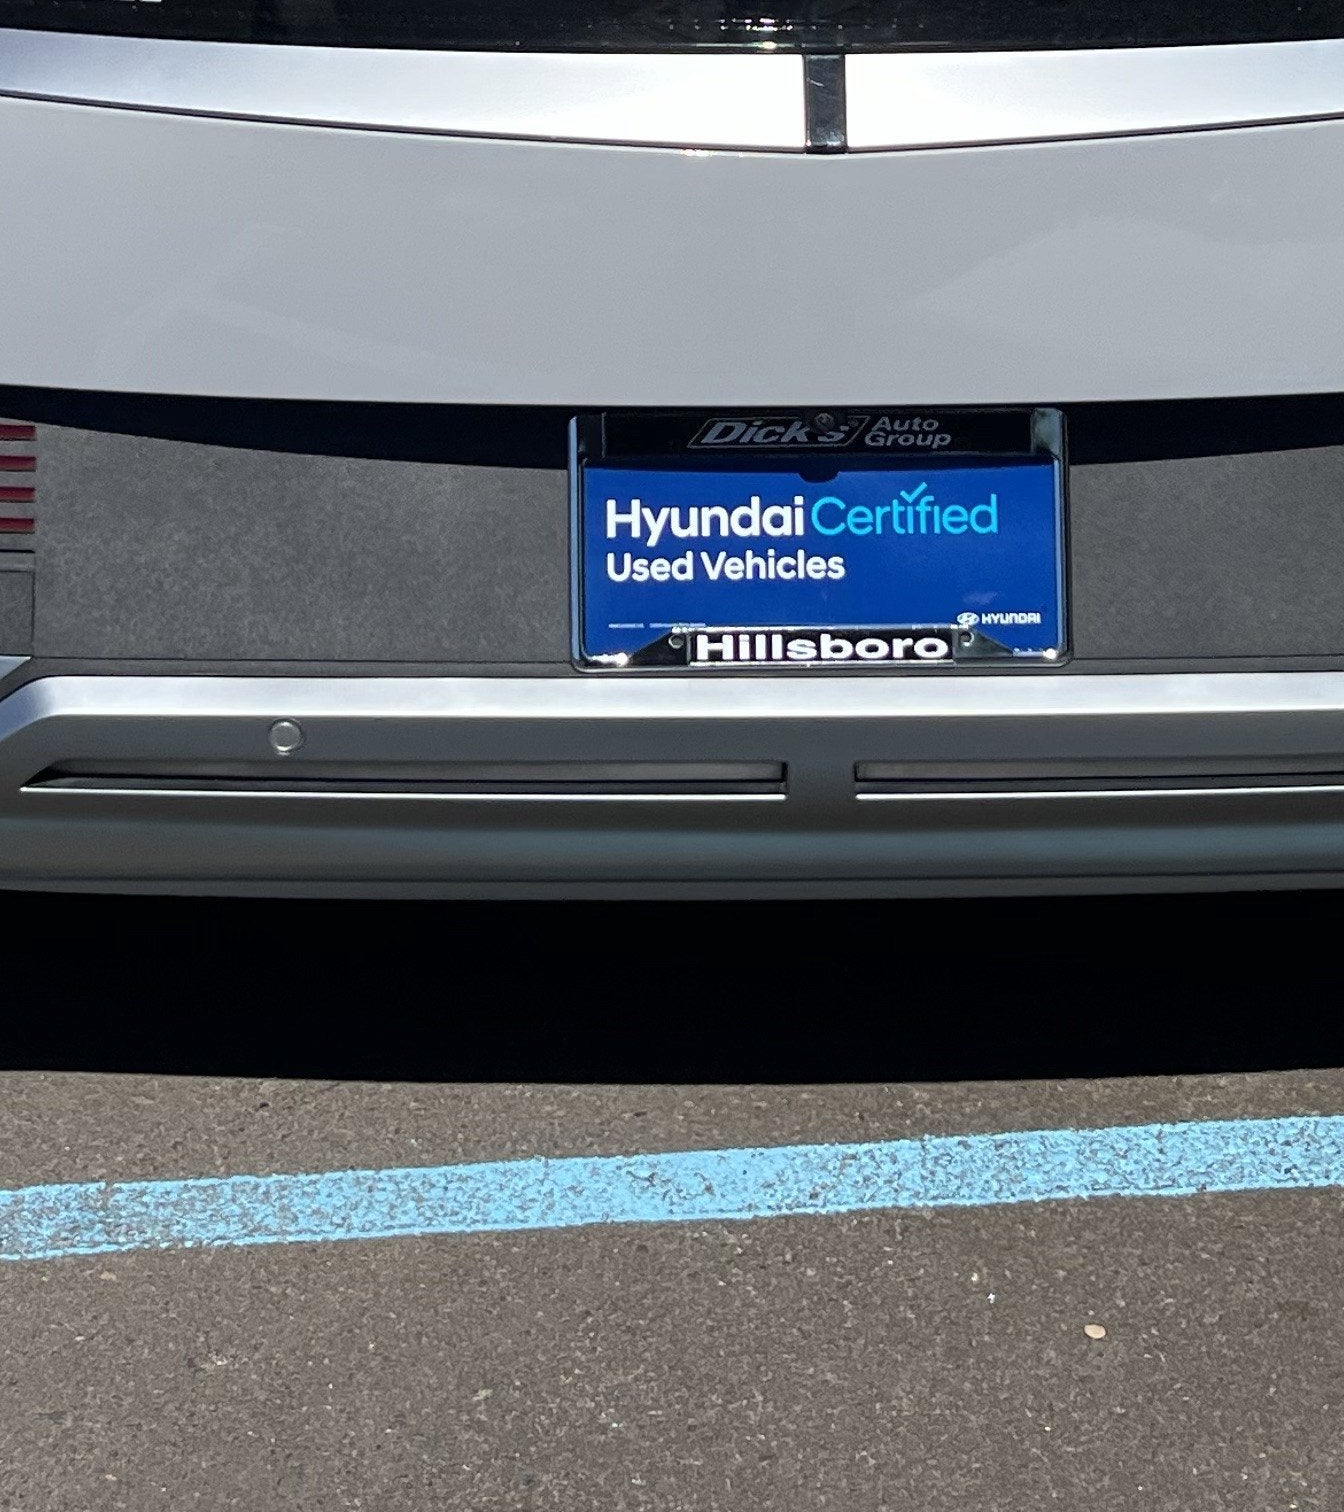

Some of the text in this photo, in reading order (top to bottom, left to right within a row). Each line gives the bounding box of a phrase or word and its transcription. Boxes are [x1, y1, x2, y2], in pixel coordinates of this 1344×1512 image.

[701, 416, 939, 444] Dicks Auto
[864, 431, 952, 449] Group
[606, 492, 999, 547] Hyundai Certified
[606, 548, 846, 582] Used Vehicles
[981, 612, 1042, 625] HYUNDAI
[695, 633, 949, 661] Hillsboro
